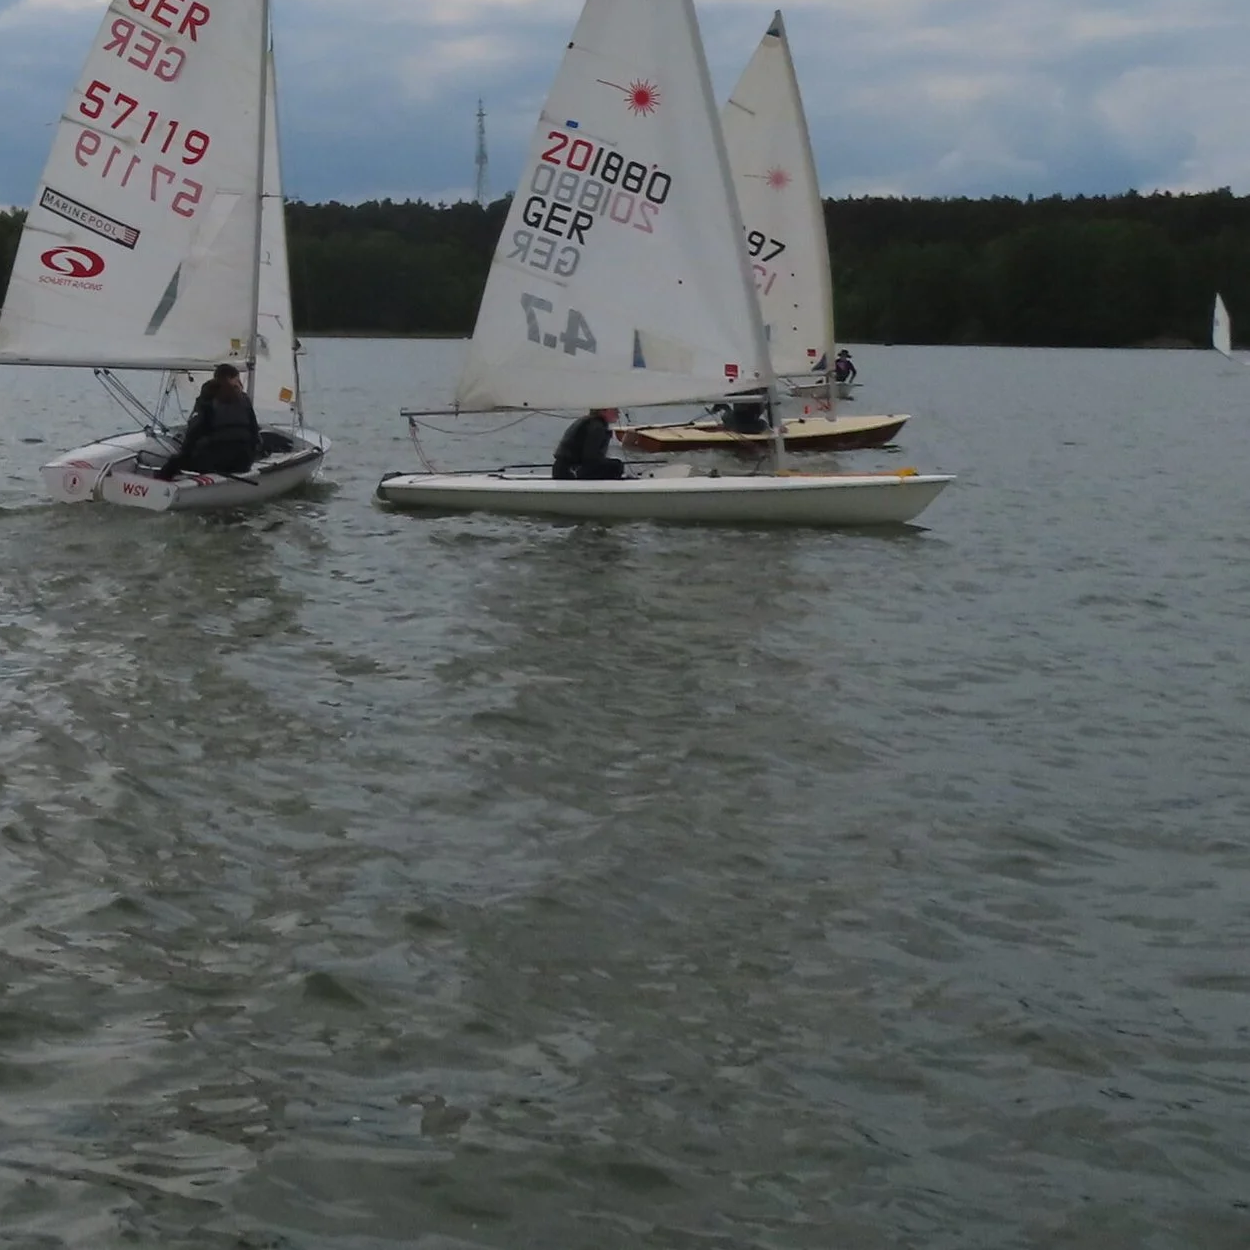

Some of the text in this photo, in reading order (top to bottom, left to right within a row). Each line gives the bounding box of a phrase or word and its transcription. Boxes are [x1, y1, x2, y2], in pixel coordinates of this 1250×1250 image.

[79, 80, 210, 165] 57119
[541, 131, 672, 204] 201880
[44, 192, 118, 236] MARINEPOOL
[522, 196, 593, 245] GER
[742, 225, 786, 262] 97
[72, 280, 104, 291] RACING
[123, 482, 150, 498] WSV
